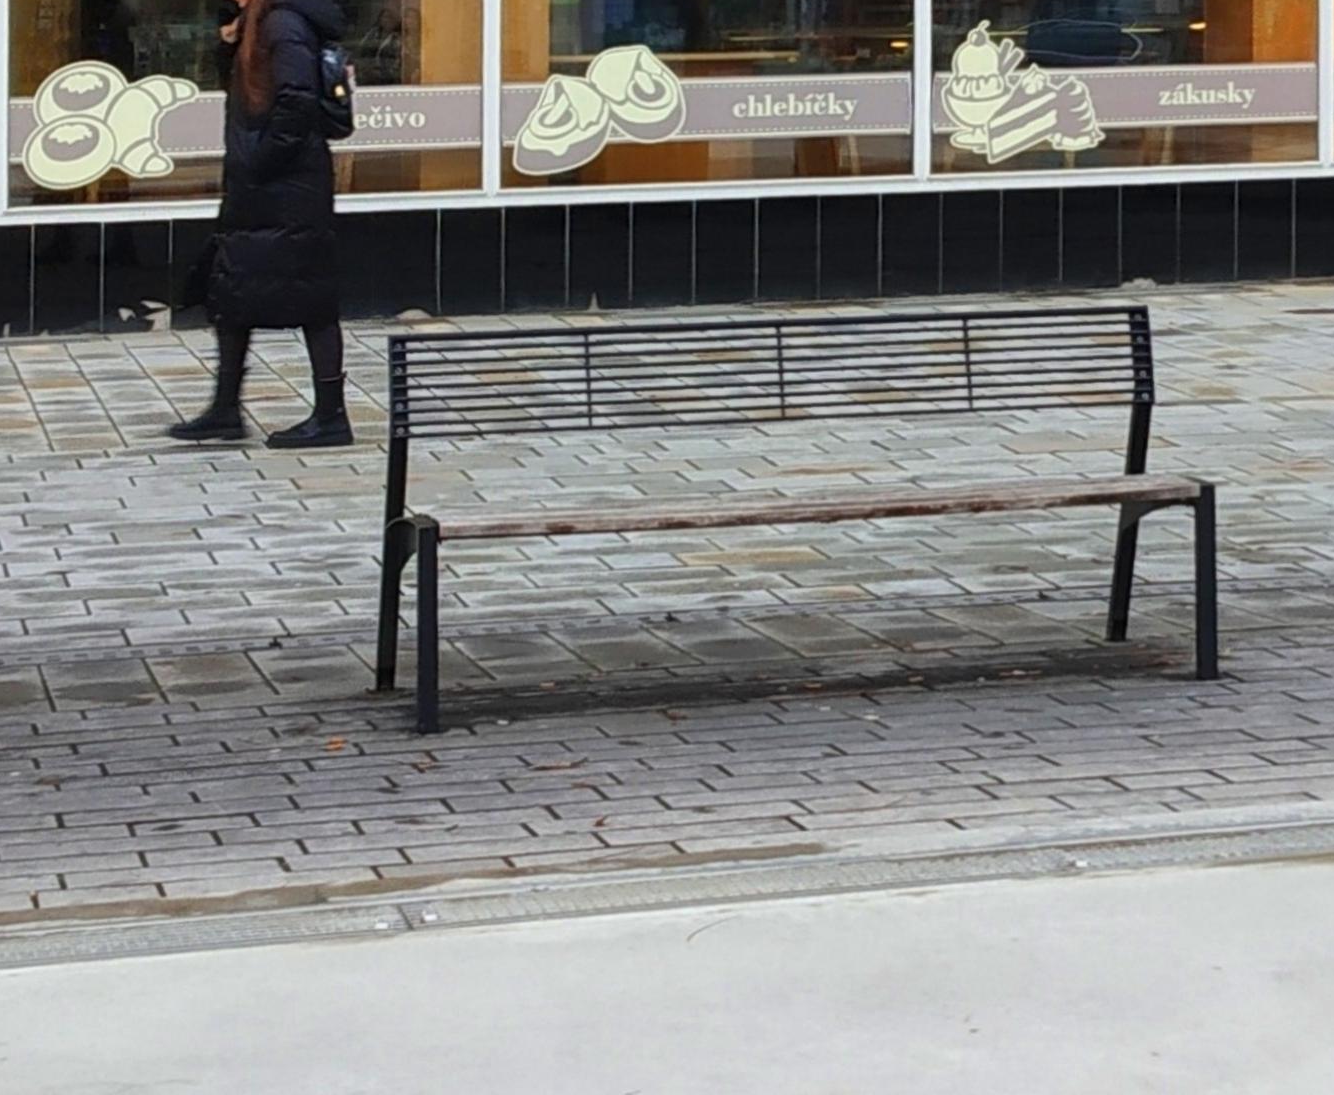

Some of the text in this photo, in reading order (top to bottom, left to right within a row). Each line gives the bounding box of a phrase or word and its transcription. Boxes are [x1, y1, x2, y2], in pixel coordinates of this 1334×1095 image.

[732, 92, 858, 121] chlebíčky
[1158, 81, 1256, 109] zákusky
[353, 105, 426, 129] ečivo
